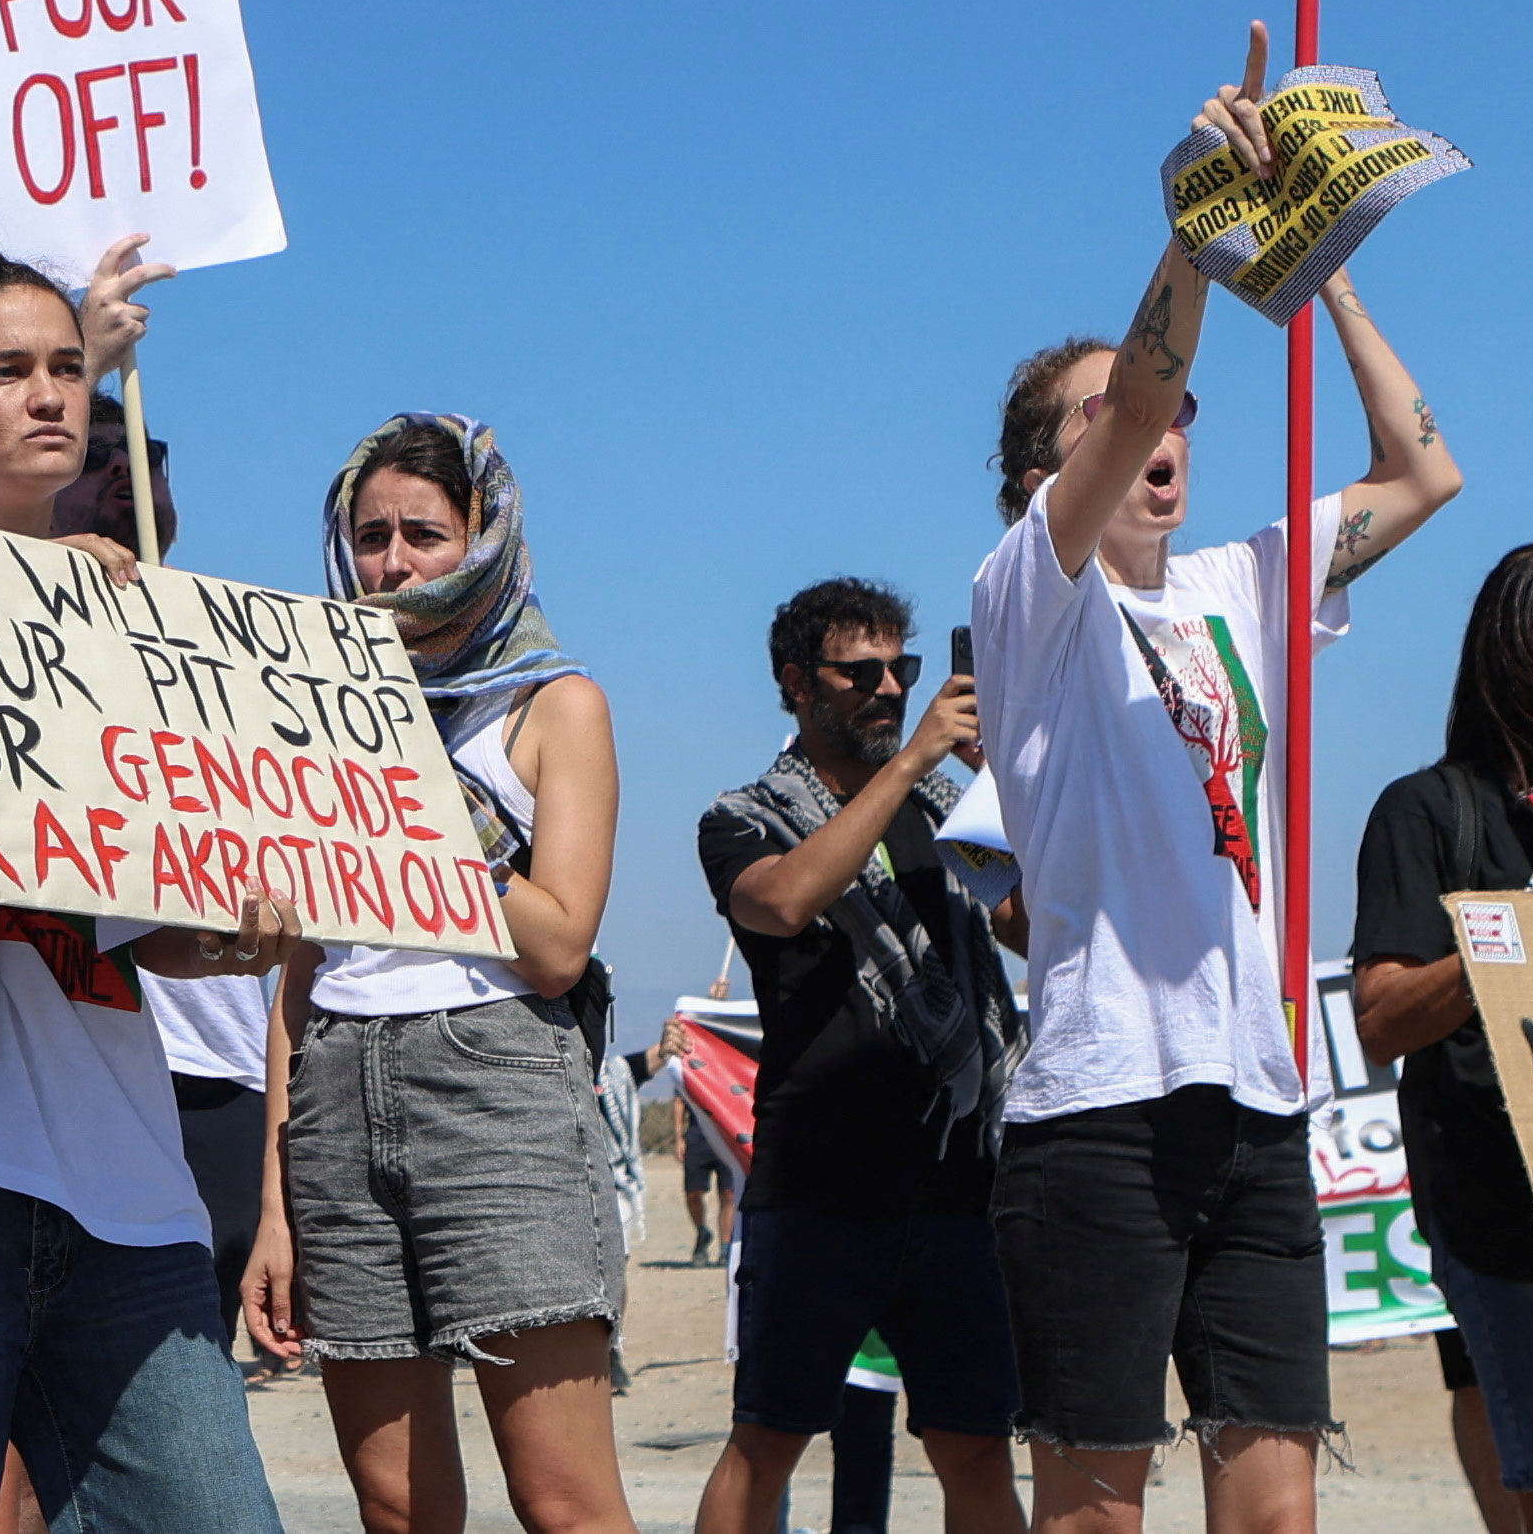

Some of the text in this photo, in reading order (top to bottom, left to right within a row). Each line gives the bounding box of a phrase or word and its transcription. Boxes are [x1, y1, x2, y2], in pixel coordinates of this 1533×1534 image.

[13, 54, 207, 205] OFF!
[1316, 89, 1367, 117] TAKE
[1172, 157, 1235, 211] STEPS
[1177, 197, 1241, 252] COULD
[1301, 204, 1325, 235] OF
[1320, 141, 1430, 217] HUNDREDS
[4, 536, 197, 649] WILL
[192, 576, 312, 667] NOT
[326, 600, 412, 684] BE
[130, 642, 237, 735] PIT
[260, 665, 416, 758] STOP
[101, 725, 445, 841] GENOCIDE
[153, 821, 394, 933] AKROTIRI
[400, 847, 501, 953] OUT
[1324, 1211, 1445, 1306] ES
